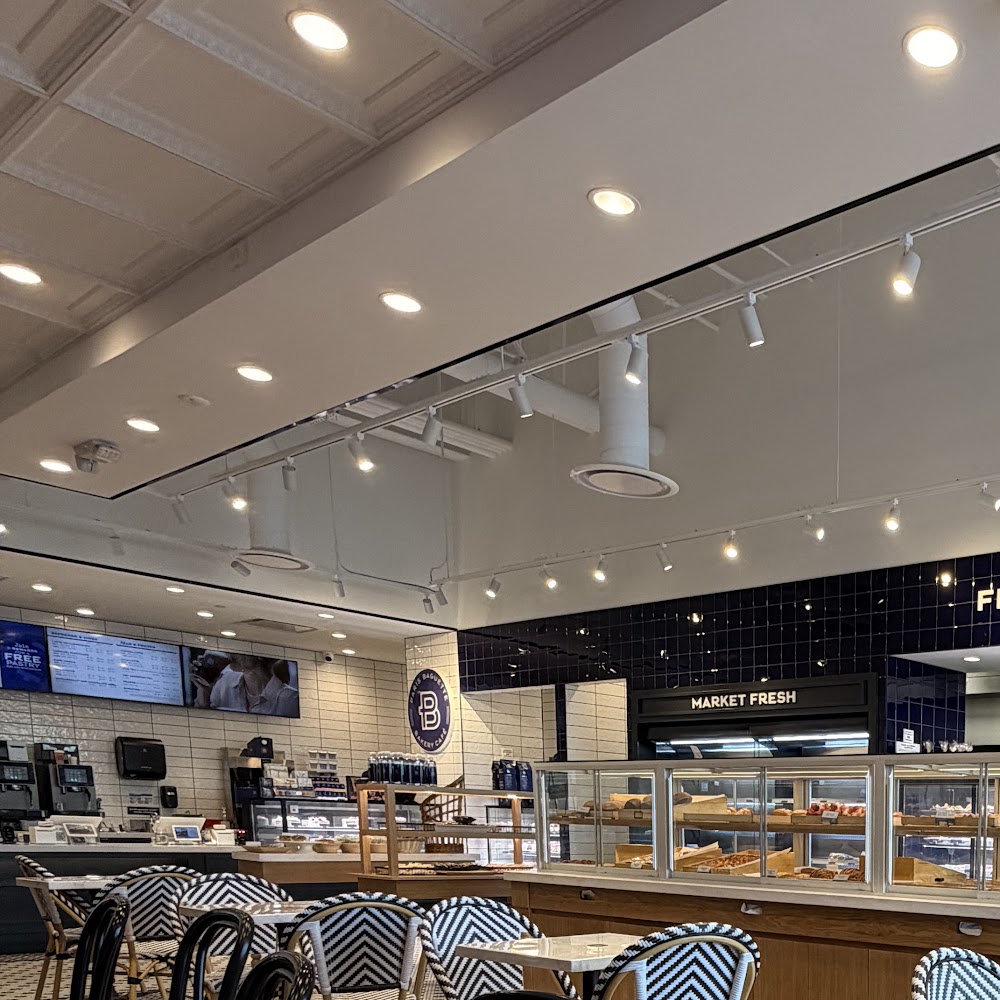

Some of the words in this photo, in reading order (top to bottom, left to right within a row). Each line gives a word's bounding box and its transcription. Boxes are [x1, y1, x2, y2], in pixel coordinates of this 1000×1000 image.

[4, 652, 41, 664] FREE
[6, 660, 41, 668] PASTRY
[422, 672, 448, 702] BAGUETTE
[691, 693, 746, 710] MARKET
[749, 690, 797, 705] FRESH
[414, 729, 434, 749] BAKERY
